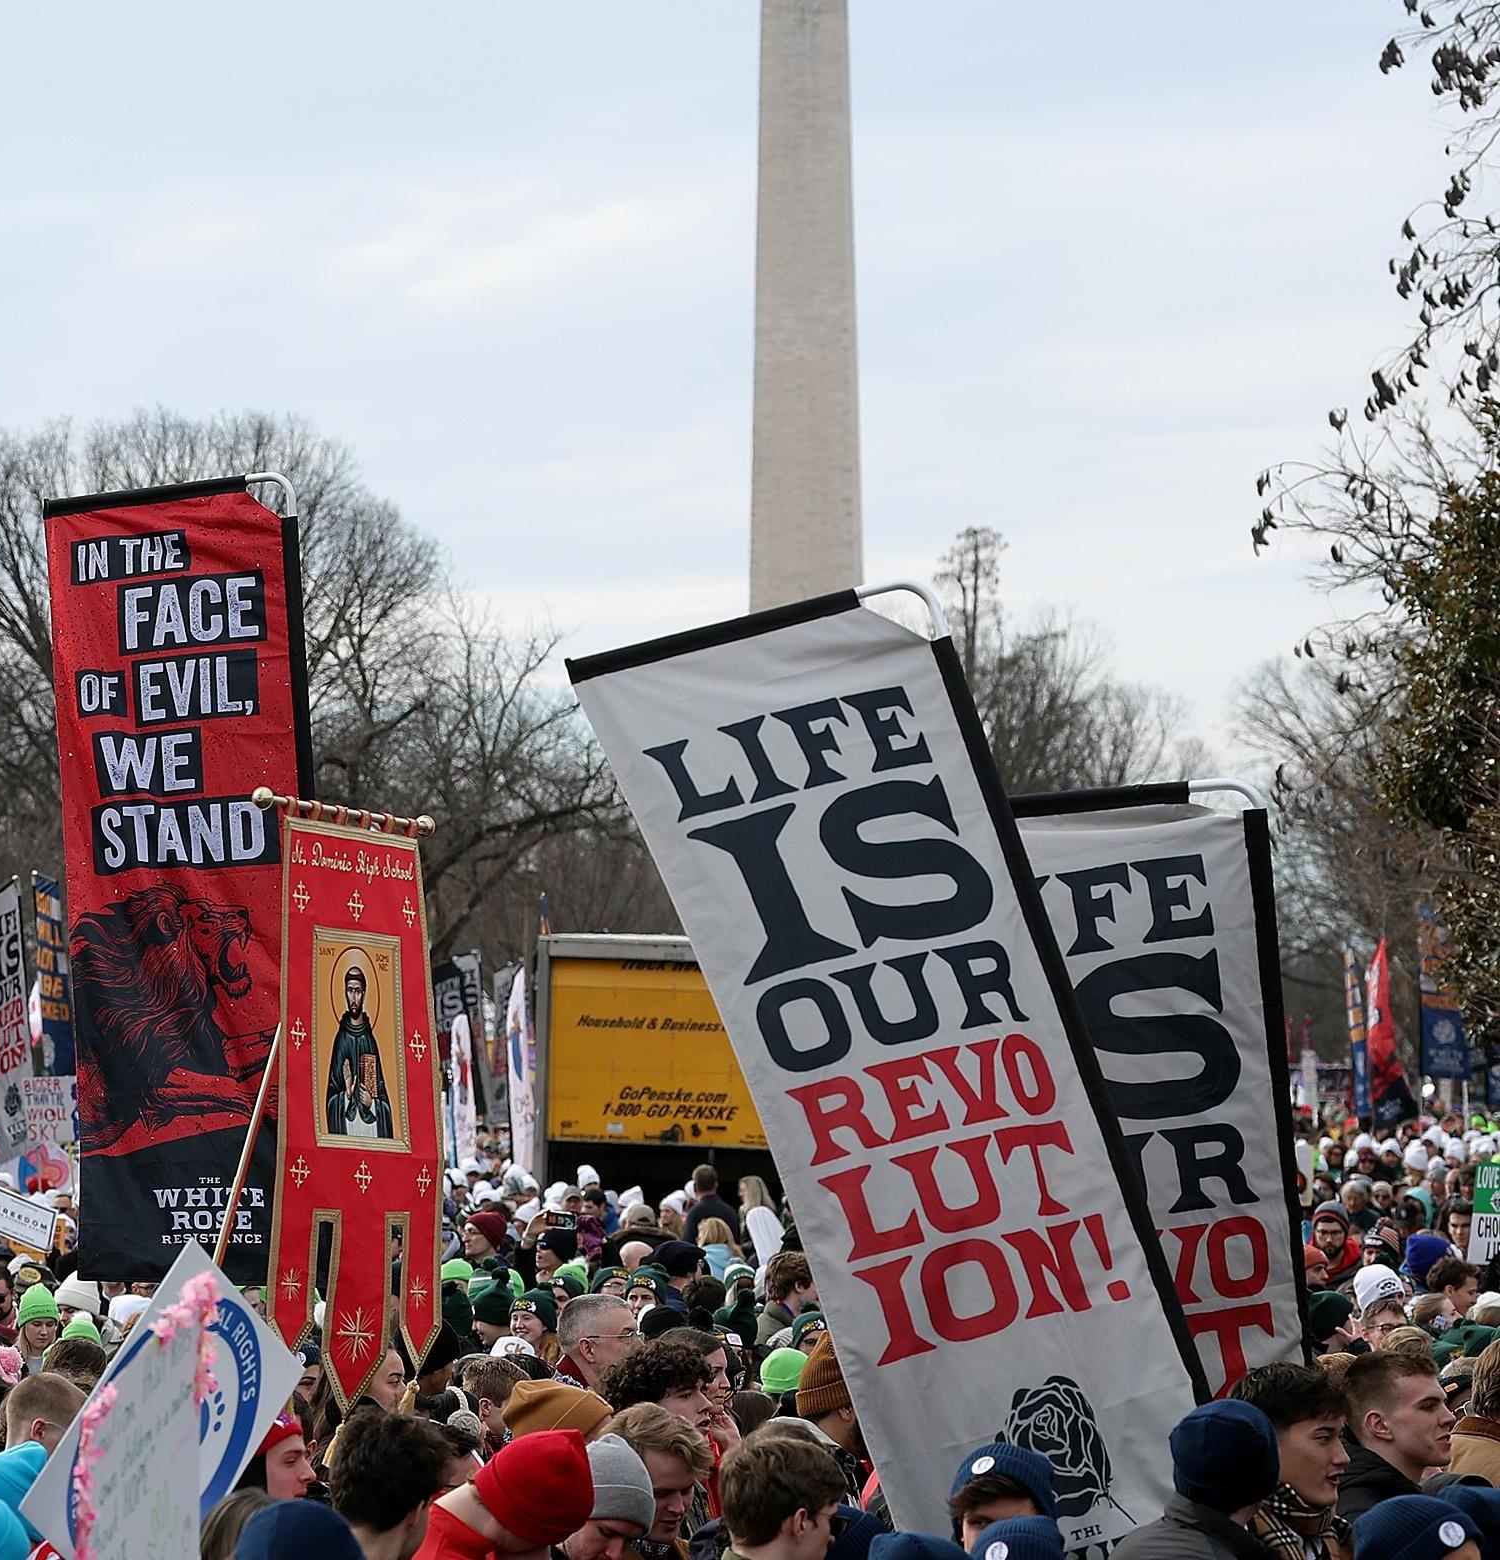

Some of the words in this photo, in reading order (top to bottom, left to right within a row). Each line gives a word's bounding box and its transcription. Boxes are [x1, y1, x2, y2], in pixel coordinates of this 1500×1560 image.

[77, 542, 109, 582] IN
[119, 533, 185, 575] THE
[124, 576, 260, 650] FACE
[79, 673, 119, 713] OF
[139, 655, 254, 723] EVIL,
[99, 732, 196, 792] WE
[643, 686, 932, 823] LIFE
[102, 801, 266, 869] STAND
[310, 842, 353, 873] Dominic
[355, 849, 381, 884] High
[382, 854, 414, 881] School
[687, 775, 994, 986] IS
[1035, 853, 1216, 956] FE
[318, 947, 336, 957] SAINT
[577, 1014, 646, 1030] Household
[646, 1016, 658, 1030] &
[756, 940, 1030, 1073] OUR
[1074, 948, 1241, 1120] S
[23, 1077, 62, 1094] BIGGER
[602, 1103, 738, 1122] 1-800-GO-PENSKE
[619, 1086, 728, 1104] GoPenske.com
[786, 1034, 1056, 1166] REVO
[27, 1122, 60, 1142] SKY
[199, 1176, 221, 1184] THE
[818, 1121, 1074, 1263] LUT
[161, 1233, 262, 1245] RESISTNCE
[170, 1210, 252, 1230] ROSE
[1478, 1216, 1500, 1238] CHO
[852, 1214, 1130, 1367] ION!
[231, 1321, 257, 1402] RIGHTS
